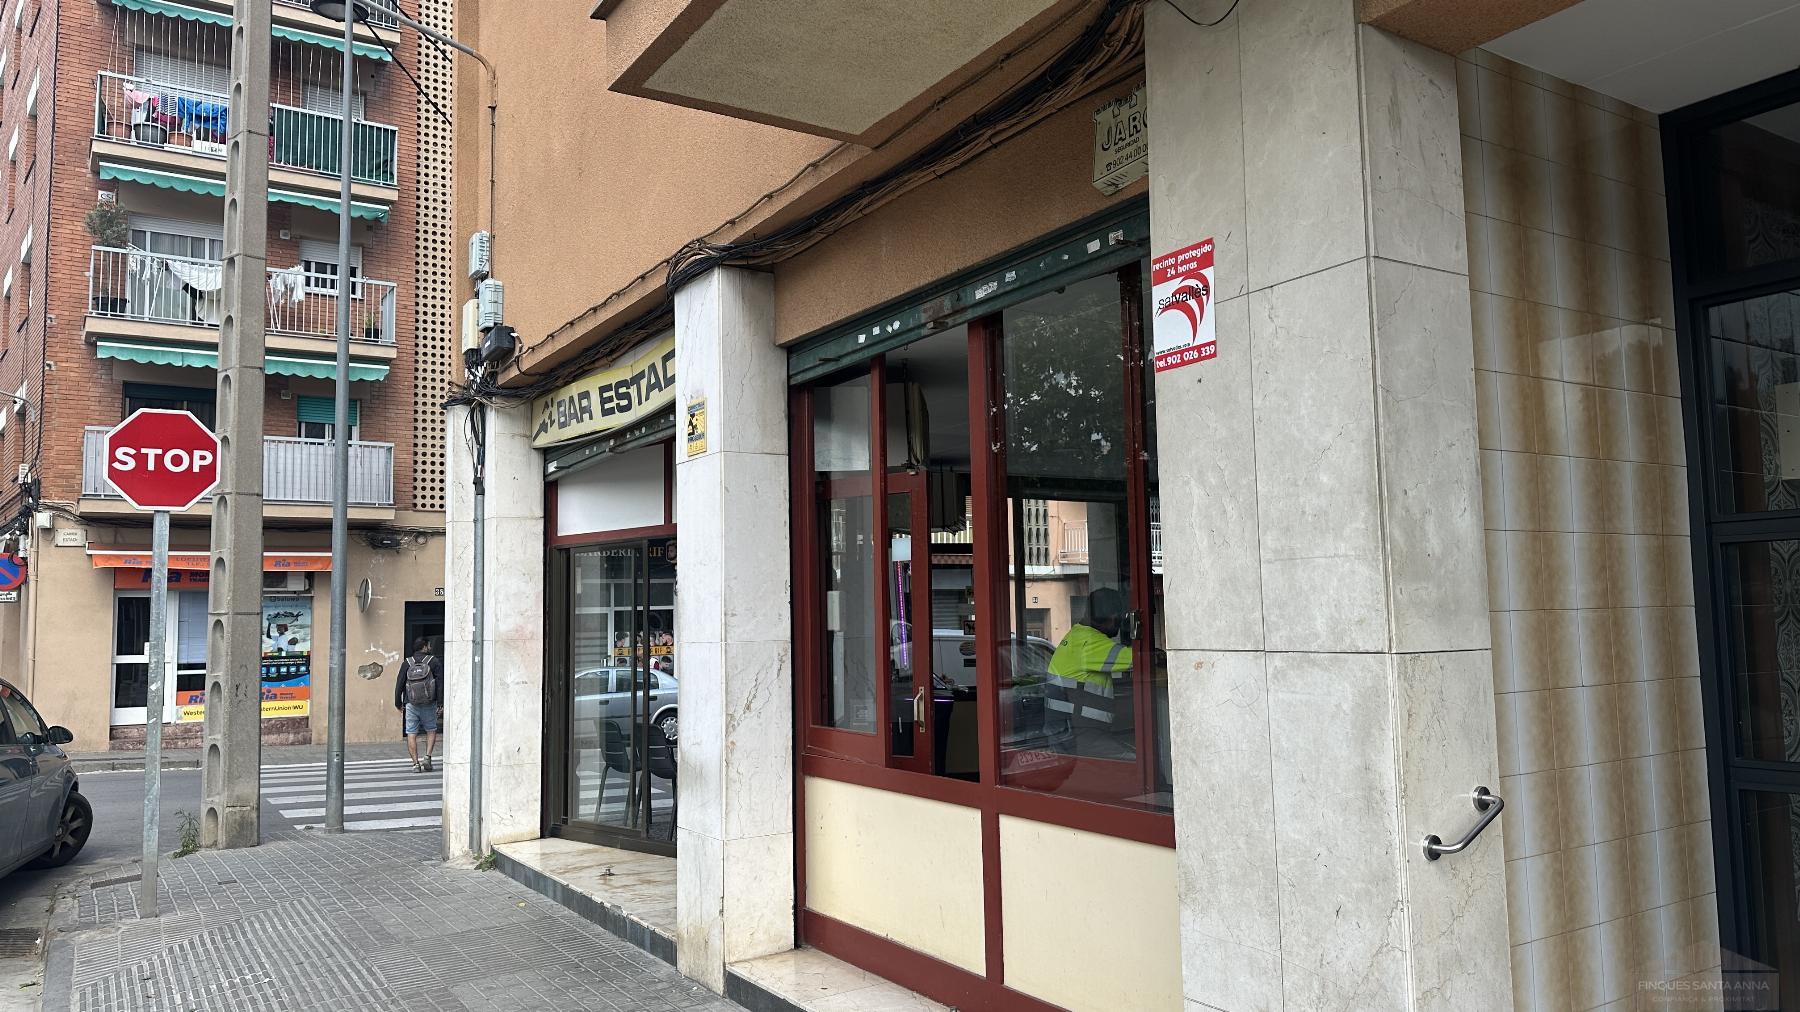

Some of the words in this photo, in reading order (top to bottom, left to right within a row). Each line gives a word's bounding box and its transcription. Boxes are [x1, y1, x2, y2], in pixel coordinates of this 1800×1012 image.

[1112, 155, 1125, 170] 902
[1125, 150, 1133, 161] 44
[1152, 257, 1176, 272] recinto
[1177, 243, 1213, 262] protegido
[1166, 268, 1176, 278] 24
[1178, 260, 1198, 274] horas
[1158, 283, 1209, 311] satvallès
[1183, 350, 1199, 362] 026
[1200, 344, 1216, 356] 339
[556, 389, 594, 430] BAR
[111, 446, 214, 473] STOP
[274, 559, 291, 568] Ria
